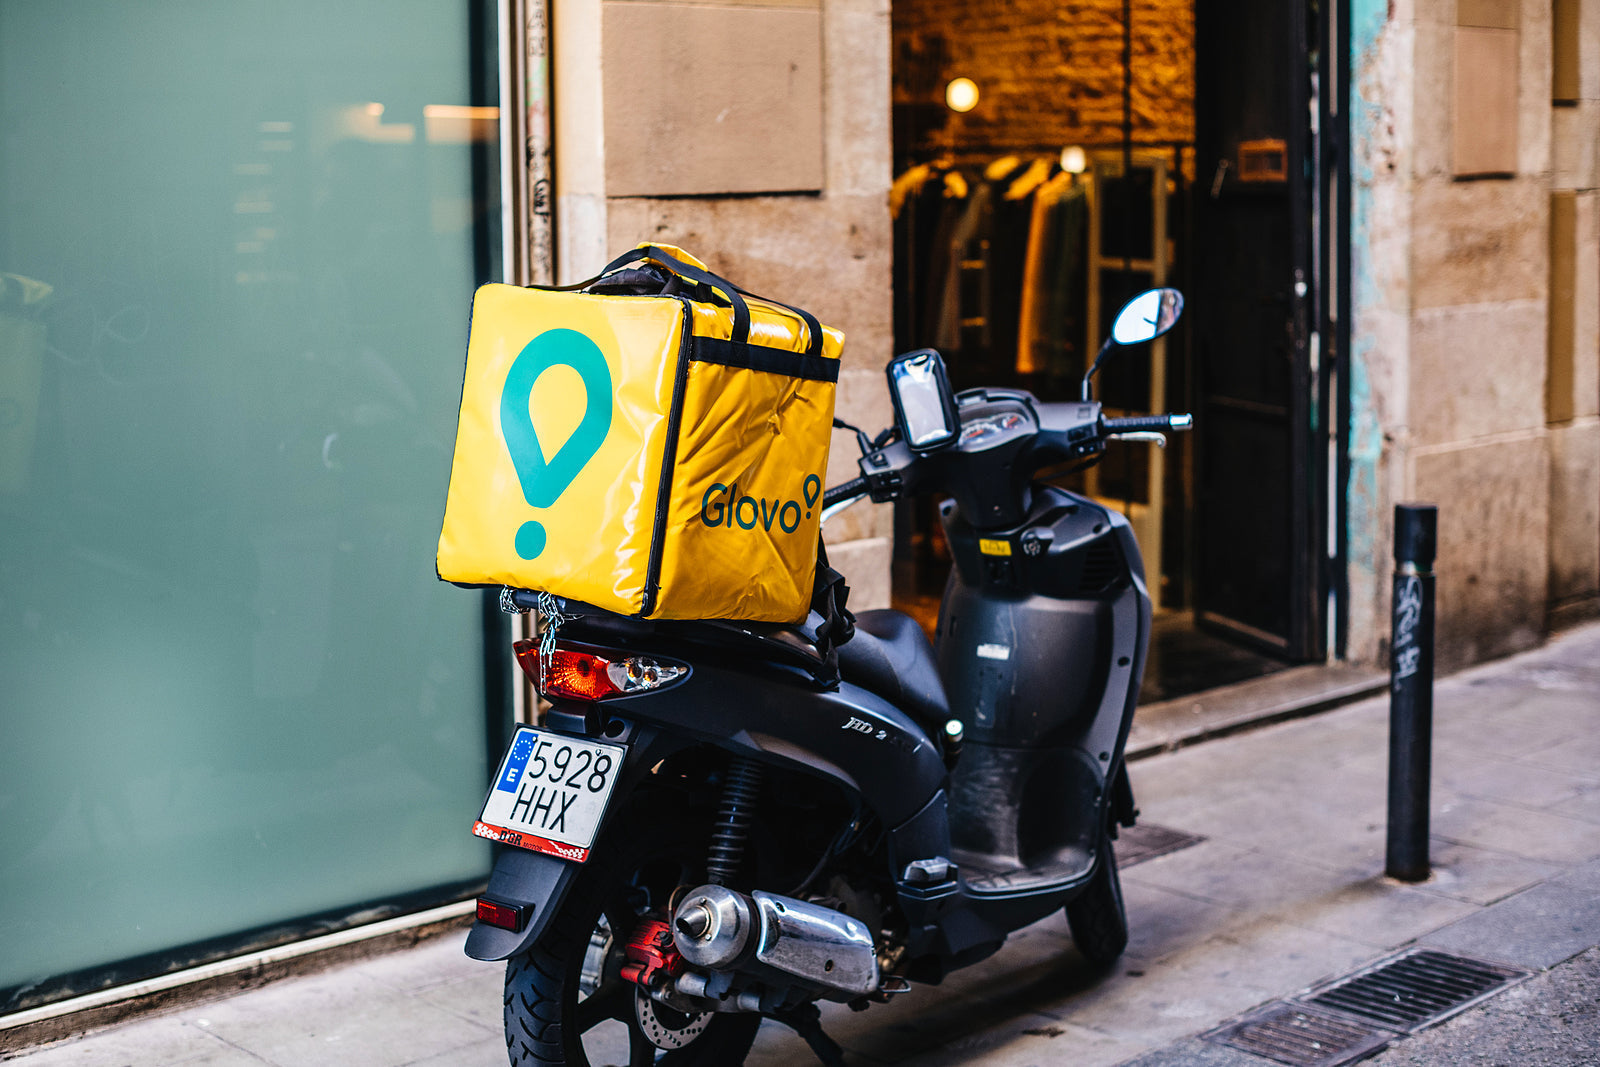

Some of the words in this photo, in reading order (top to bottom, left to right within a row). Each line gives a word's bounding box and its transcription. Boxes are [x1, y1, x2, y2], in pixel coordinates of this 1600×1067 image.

[701, 483, 801, 534] Glovo
[506, 768, 519, 782] E
[528, 741, 612, 793] 5928
[509, 783, 578, 833] HHX
